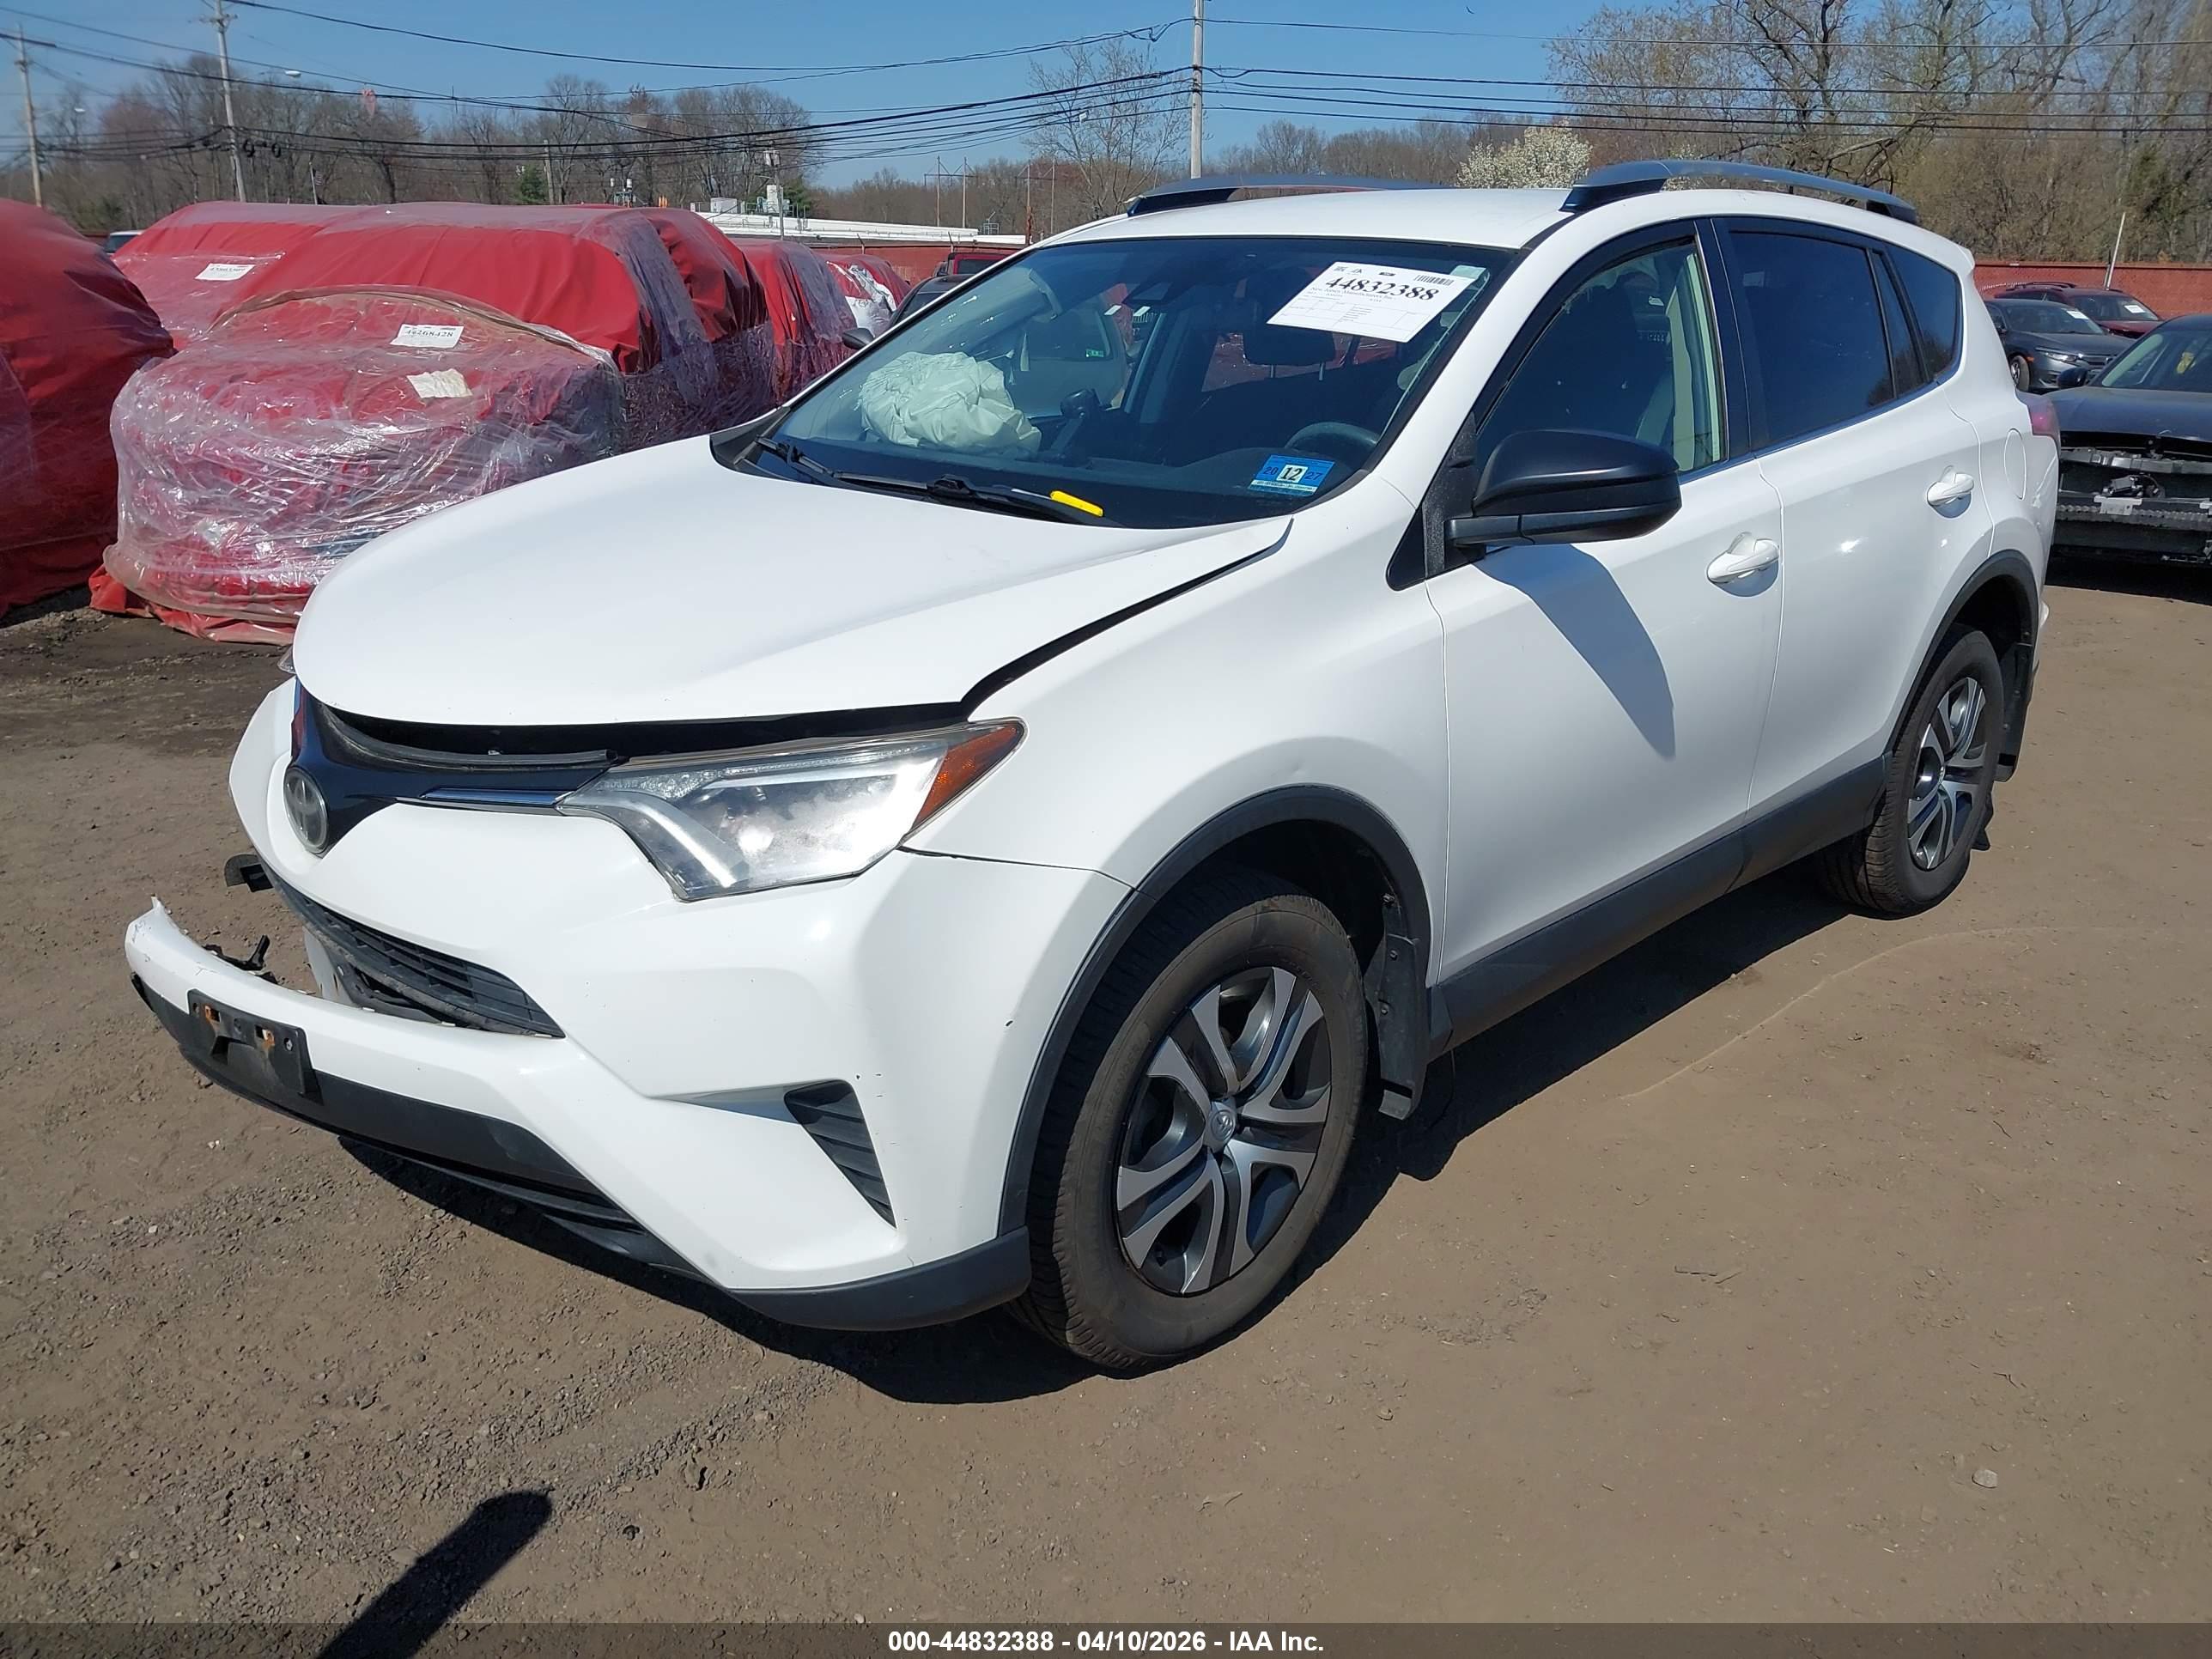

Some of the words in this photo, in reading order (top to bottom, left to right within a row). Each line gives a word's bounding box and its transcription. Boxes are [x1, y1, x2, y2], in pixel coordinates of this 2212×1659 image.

[1325, 276, 1440, 301] 44832388
[1263, 466, 1279, 476] 20
[1280, 466, 1300, 481] 12
[1304, 471, 1322, 481] 27
